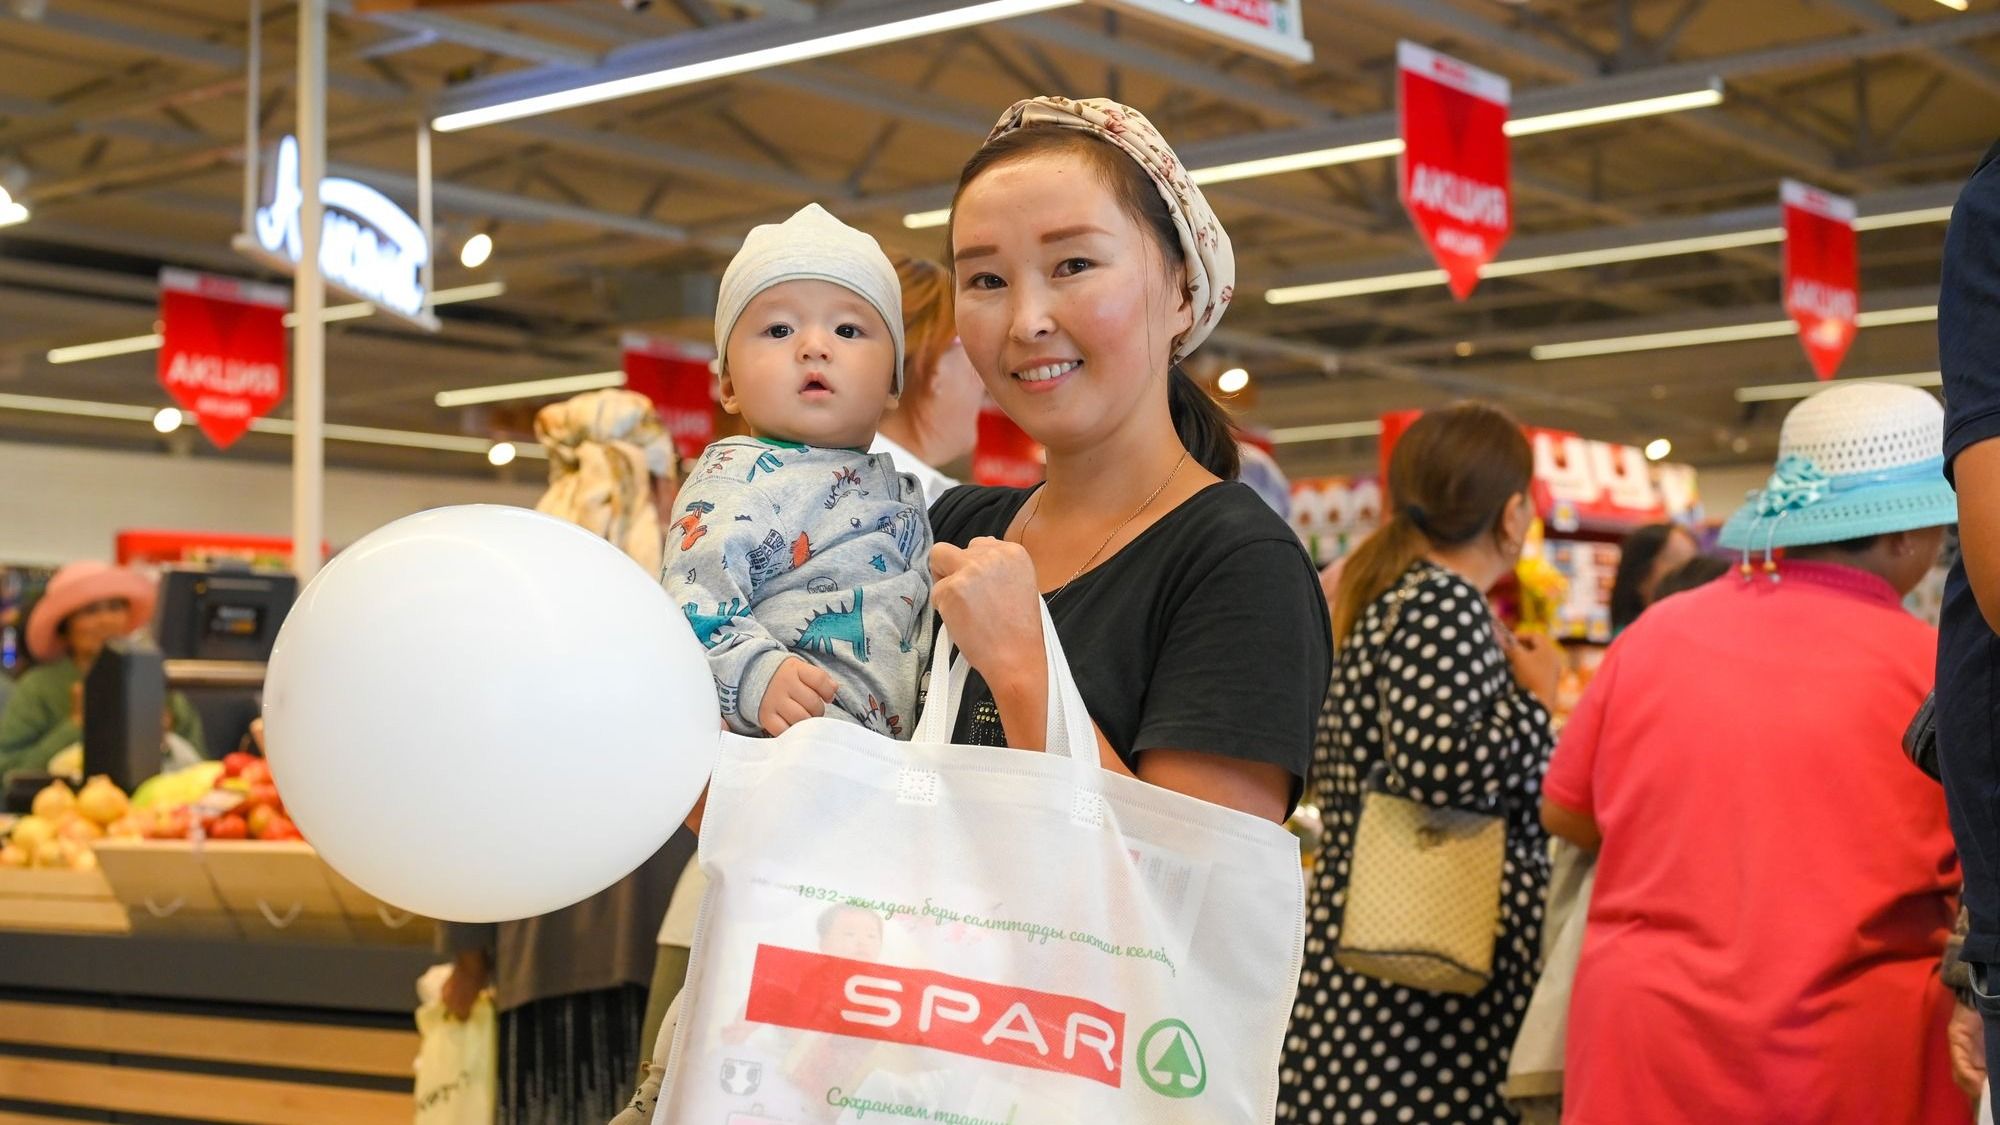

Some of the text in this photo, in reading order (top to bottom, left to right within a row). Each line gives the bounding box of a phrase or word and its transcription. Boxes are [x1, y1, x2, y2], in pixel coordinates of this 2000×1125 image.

[921, 898, 960, 925] бери
[963, 914, 1066, 944] салттарды
[1070, 931, 1122, 956] сактап
[840, 974, 1116, 1072] SPAR
[826, 1086, 929, 1119] Сохраняем
